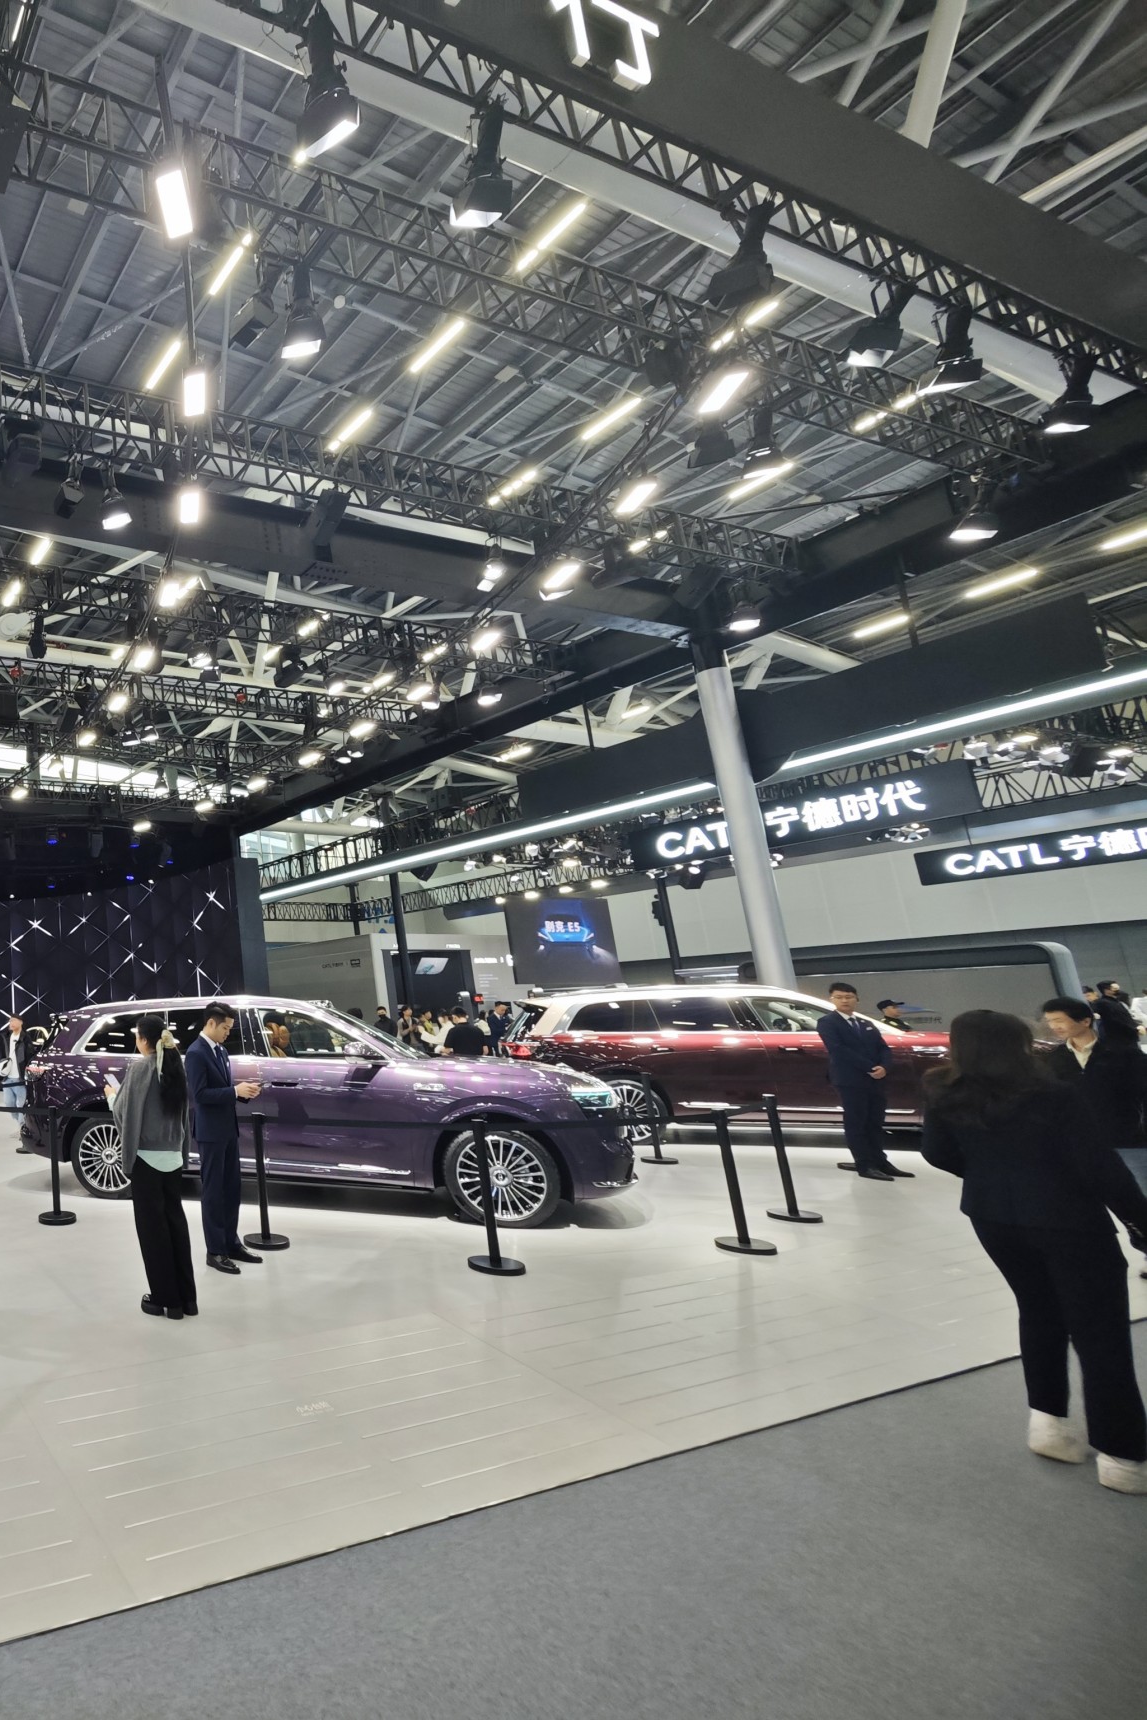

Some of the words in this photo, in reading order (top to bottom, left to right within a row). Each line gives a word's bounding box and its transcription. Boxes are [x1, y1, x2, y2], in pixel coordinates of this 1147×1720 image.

[656, 821, 730, 858] CAT
[765, 779, 927, 838] 宁德时代
[944, 843, 1061, 875] CATL
